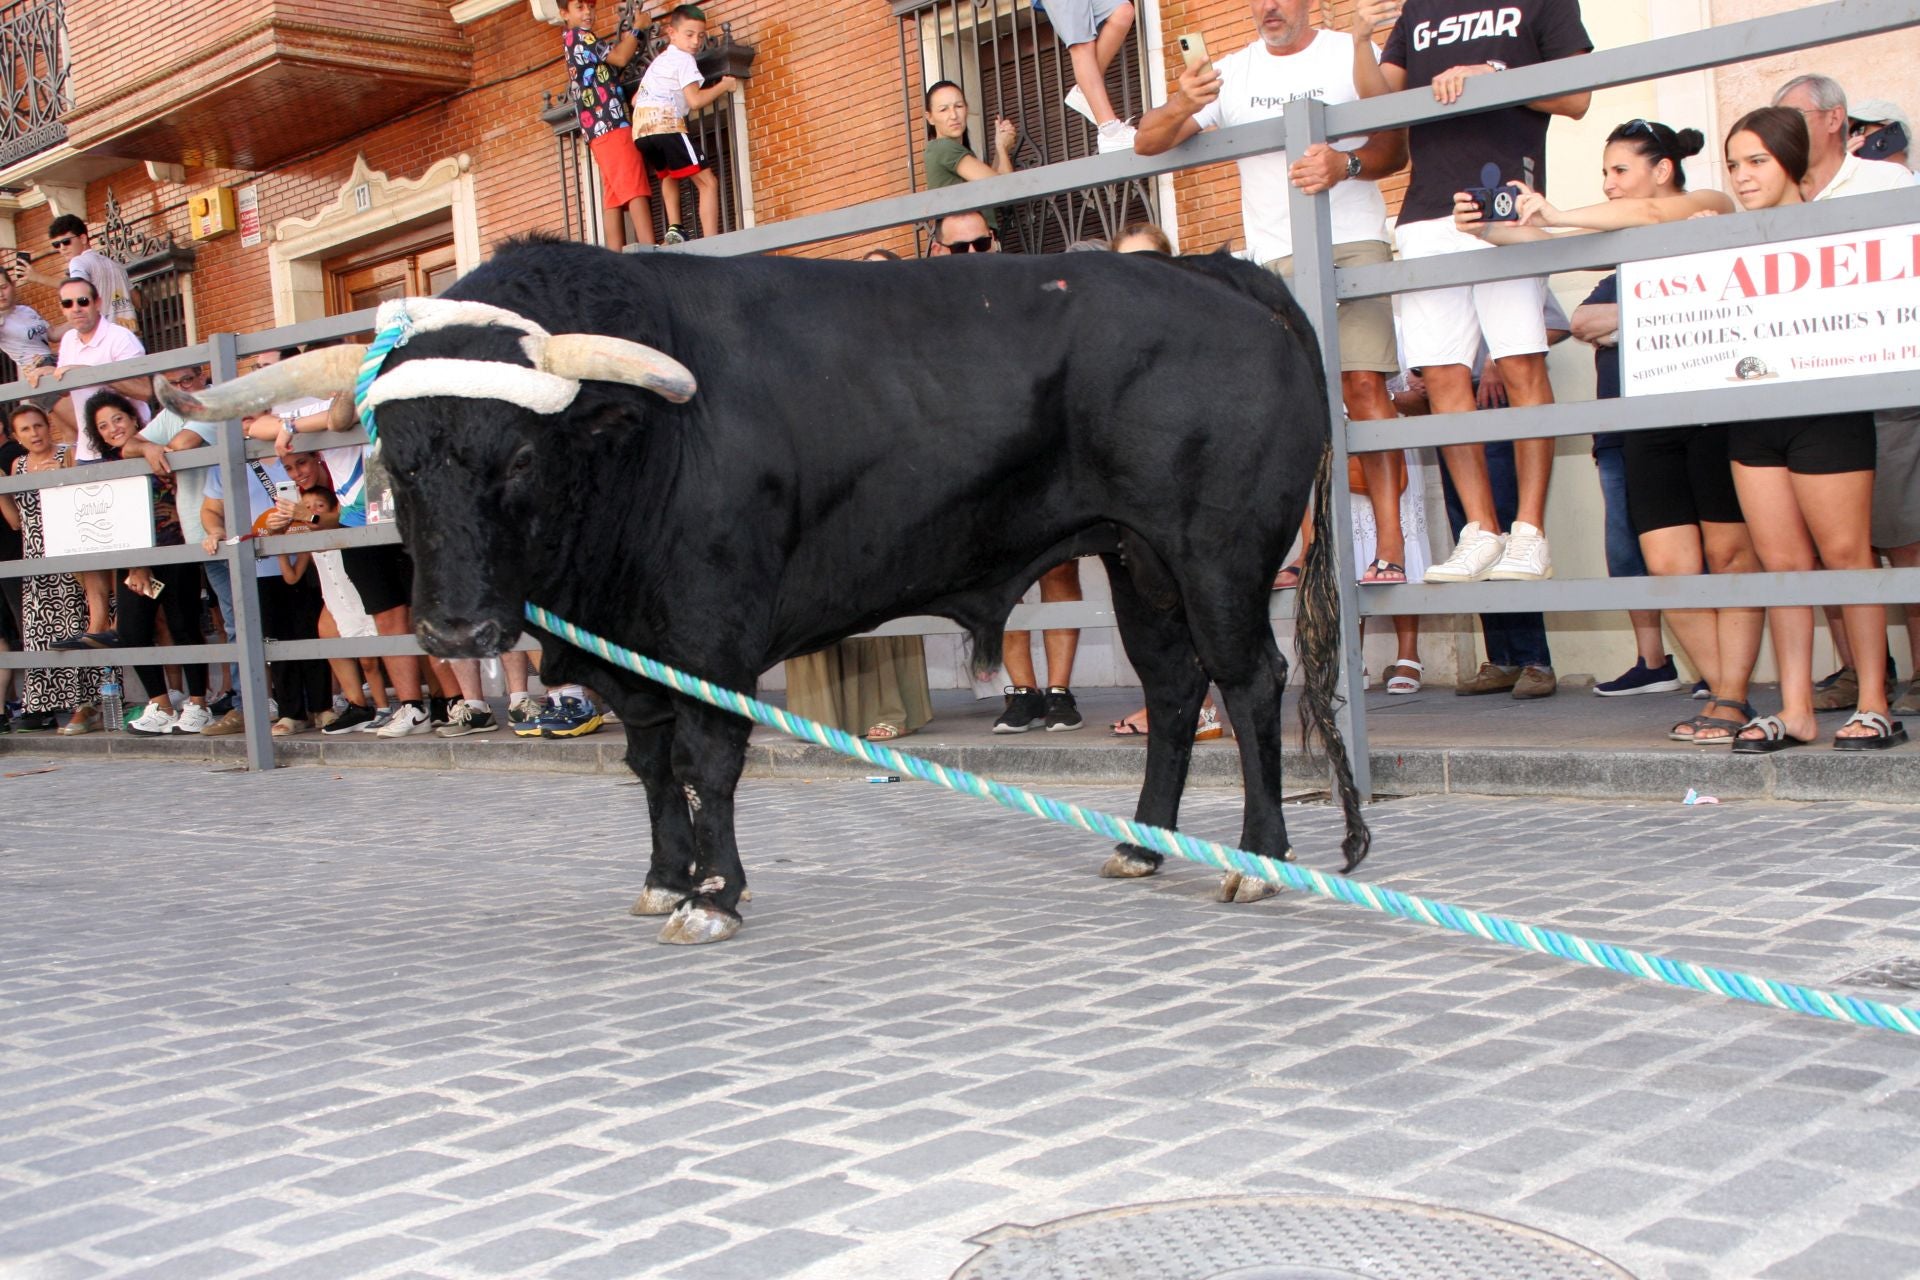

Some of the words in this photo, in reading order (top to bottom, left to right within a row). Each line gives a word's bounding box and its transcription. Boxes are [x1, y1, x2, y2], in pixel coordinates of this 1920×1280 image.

[1413, 7, 1522, 51] G-STAR
[1250, 96, 1284, 109] Pepe
[356, 187, 366, 208] 17
[1634, 273, 1707, 300] CASA
[1636, 307, 1731, 329] ESPECIALIDAD
[1736, 304, 1754, 317] EN
[1754, 311, 1869, 340] CALAMARES
[1876, 308, 1889, 326] Y
[1632, 364, 1677, 380] SERVICIO
[1681, 349, 1739, 371] AGRADABLE
[1790, 352, 1855, 370] Visítanos
[1859, 352, 1878, 363] en
[1882, 347, 1896, 361] la
